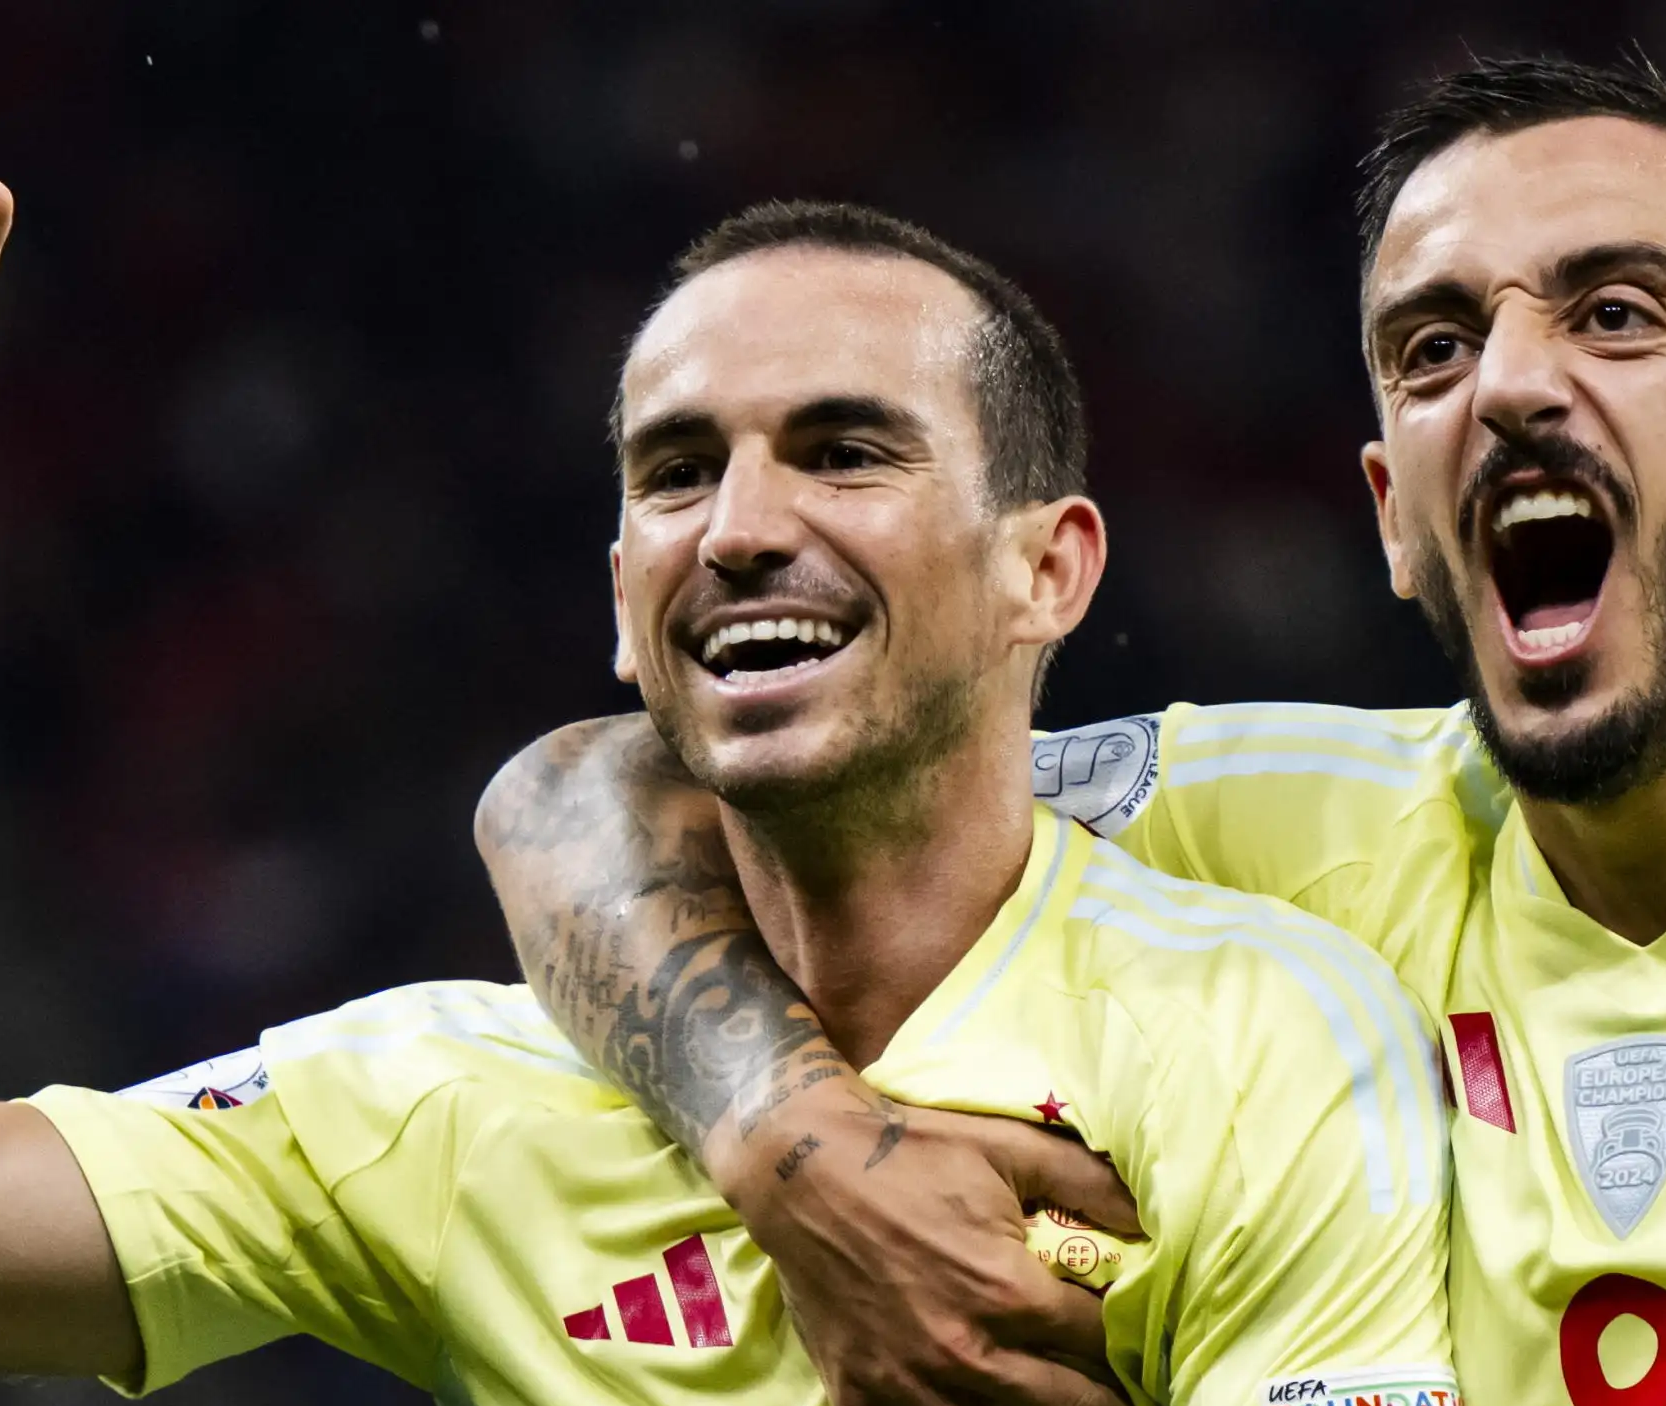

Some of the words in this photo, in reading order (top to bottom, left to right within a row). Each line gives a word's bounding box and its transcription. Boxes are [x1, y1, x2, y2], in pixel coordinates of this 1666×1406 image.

[1617, 1048, 1661, 1064] UEFA
[1598, 1168, 1654, 1188] 2024
[1269, 1380, 1327, 1403] UEFA
